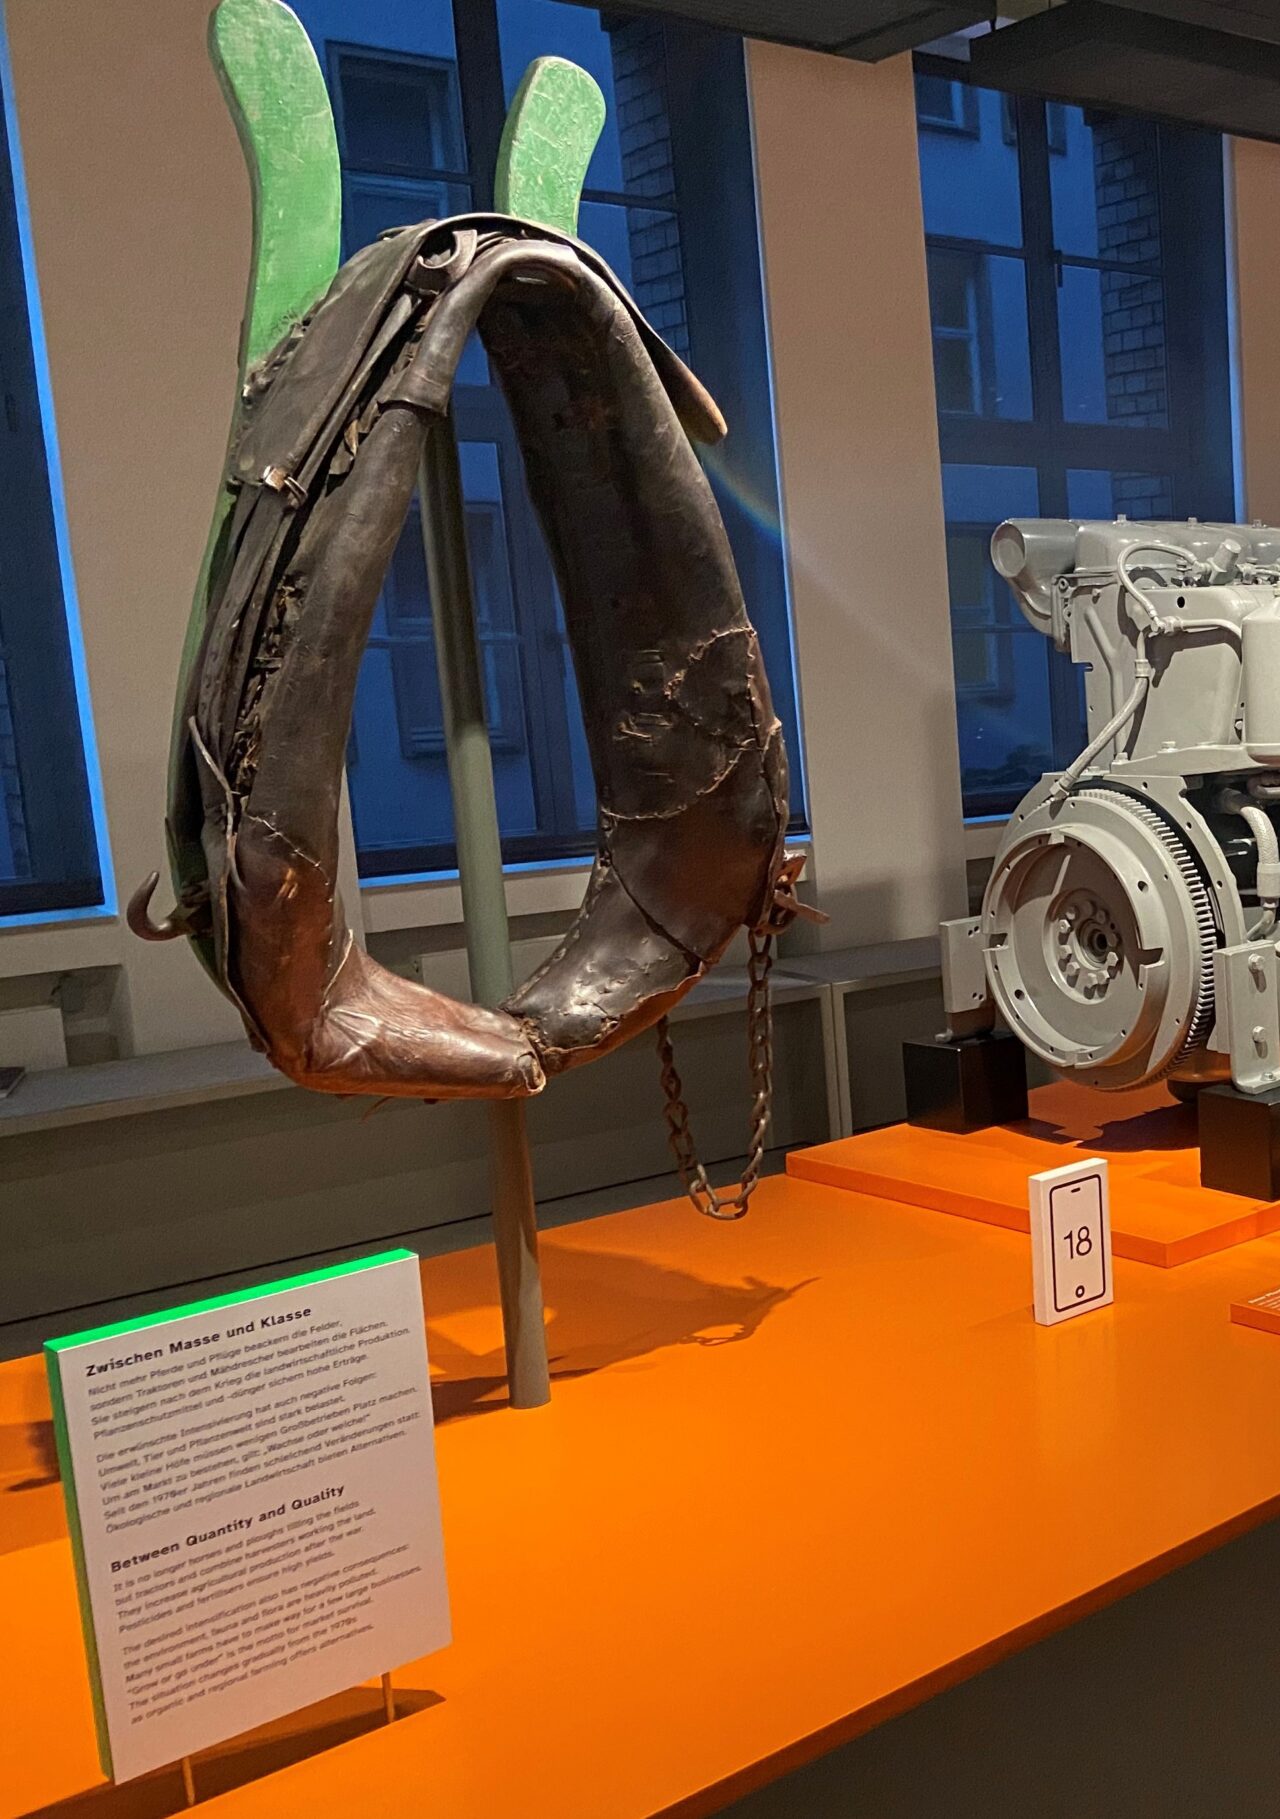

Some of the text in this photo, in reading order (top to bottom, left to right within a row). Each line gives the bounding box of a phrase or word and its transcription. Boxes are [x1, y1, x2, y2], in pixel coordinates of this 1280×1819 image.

[1063, 1226, 1093, 1260] 18
[85, 1307, 311, 1377] Zwischen Masse und Klasse
[87, 1381, 116, 1396] Nicht
[119, 1374, 146, 1388] mehr
[149, 1363, 183, 1379] Pferde
[186, 1356, 206, 1369] und
[208, 1347, 241, 1363] Pflüge
[243, 1334, 289, 1353] beackern
[291, 1329, 307, 1339] die
[90, 1393, 132, 1412] sondern
[137, 1378, 185, 1398] Traktoren
[188, 1371, 207, 1383] und
[276, 1337, 329, 1358] bearbeiten
[331, 1332, 346, 1342] die
[349, 1321, 388, 1337] Flächen.
[91, 1328, 409, 1425] Sie steigern nach dem Krieg die landwirtschaftliche Produktion.
[205, 1394, 224, 1407] und
[268, 1372, 303, 1388] sichern
[306, 1364, 330, 1377] hohe
[332, 1354, 367, 1369] Erträge.
[96, 1451, 114, 1463] Die
[180, 1409, 252, 1437] Intensivierung
[255, 1403, 271, 1414] hat
[274, 1395, 297, 1409] auch
[299, 1383, 340, 1401] negative
[100, 1477, 127, 1491] Viele
[130, 1466, 162, 1481] kleine
[165, 1457, 190, 1471] Höfe
[193, 1444, 232, 1462] müssen
[235, 1430, 277, 1449] wenigen
[352, 1399, 376, 1412] Platz
[143, 1451, 163, 1463] Tier
[166, 1443, 186, 1456] und
[188, 1423, 252, 1449] Pflanzenwelt
[254, 1416, 276, 1429] sind
[278, 1408, 302, 1421] stark
[102, 1494, 120, 1505] Um
[123, 1488, 139, 1499] am
[175, 1473, 187, 1482] zu
[306, 1428, 328, 1440] oder
[104, 1506, 125, 1519] Seit
[128, 1499, 148, 1512] den
[192, 1475, 225, 1491] Jahren
[228, 1463, 260, 1479] finden
[263, 1443, 322, 1468] schleichend
[324, 1420, 394, 1448] Veränderungen
[105, 1507, 170, 1534] Ökologische
[173, 1499, 192, 1512] und
[194, 1484, 242, 1505] regionale
[244, 1459, 315, 1488] Landwirtschaft
[317, 1449, 348, 1464] bieten
[110, 1486, 344, 1573] Between Quantity and Quality
